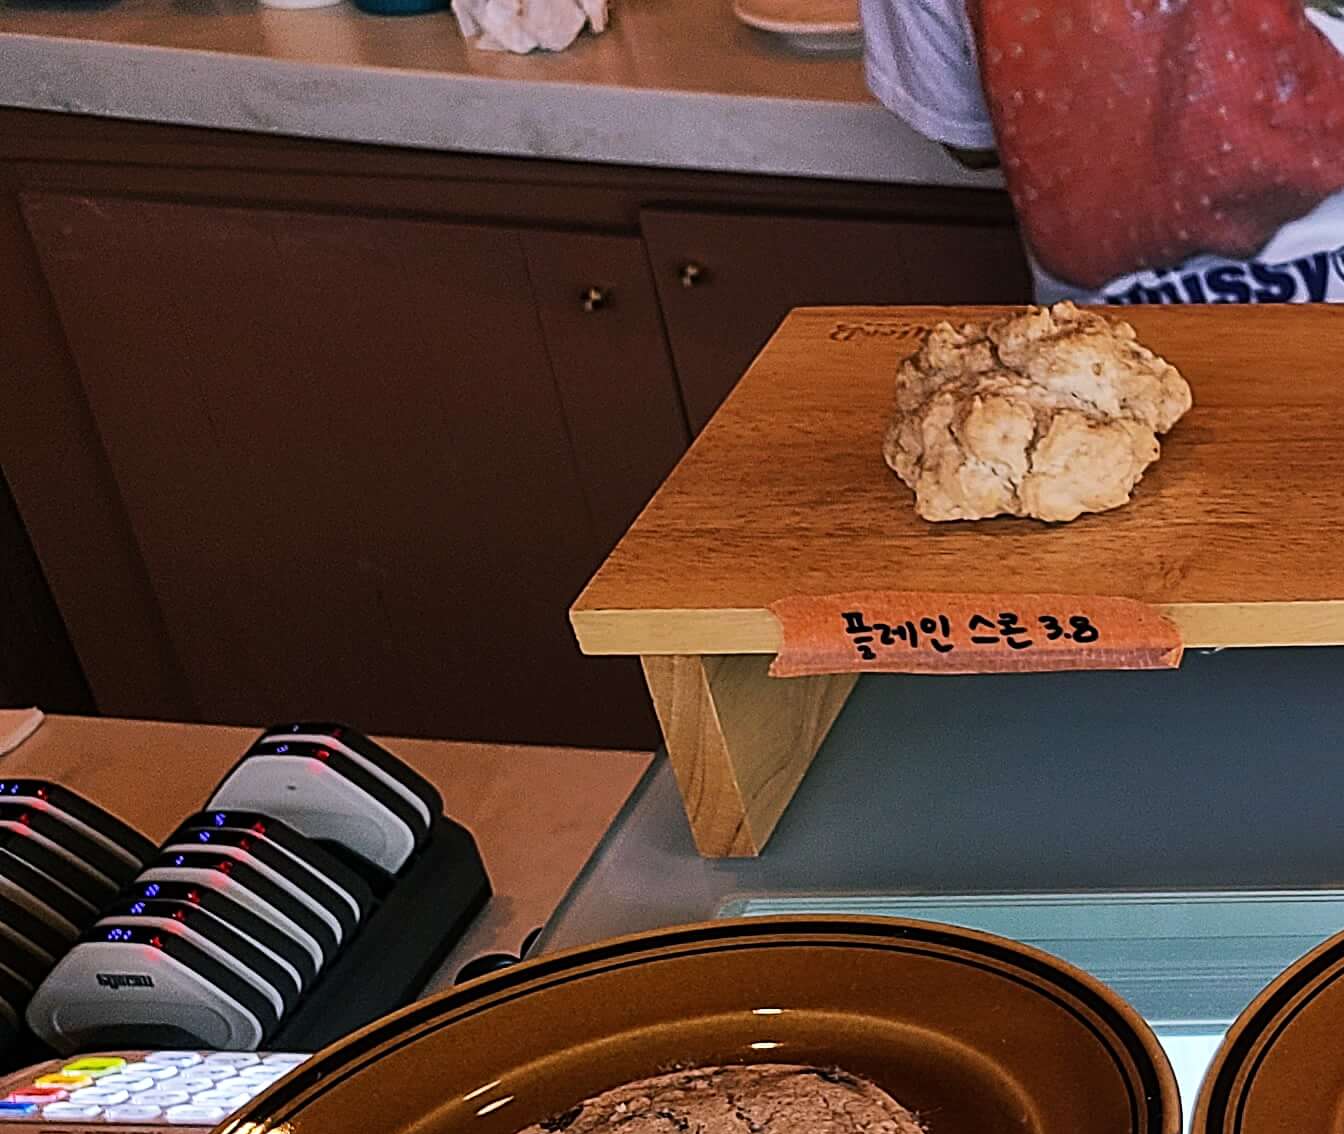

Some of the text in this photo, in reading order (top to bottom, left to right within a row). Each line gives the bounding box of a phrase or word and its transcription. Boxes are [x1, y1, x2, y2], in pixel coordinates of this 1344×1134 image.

[841, 611, 1099, 660] 플레인 스콘 3.8
